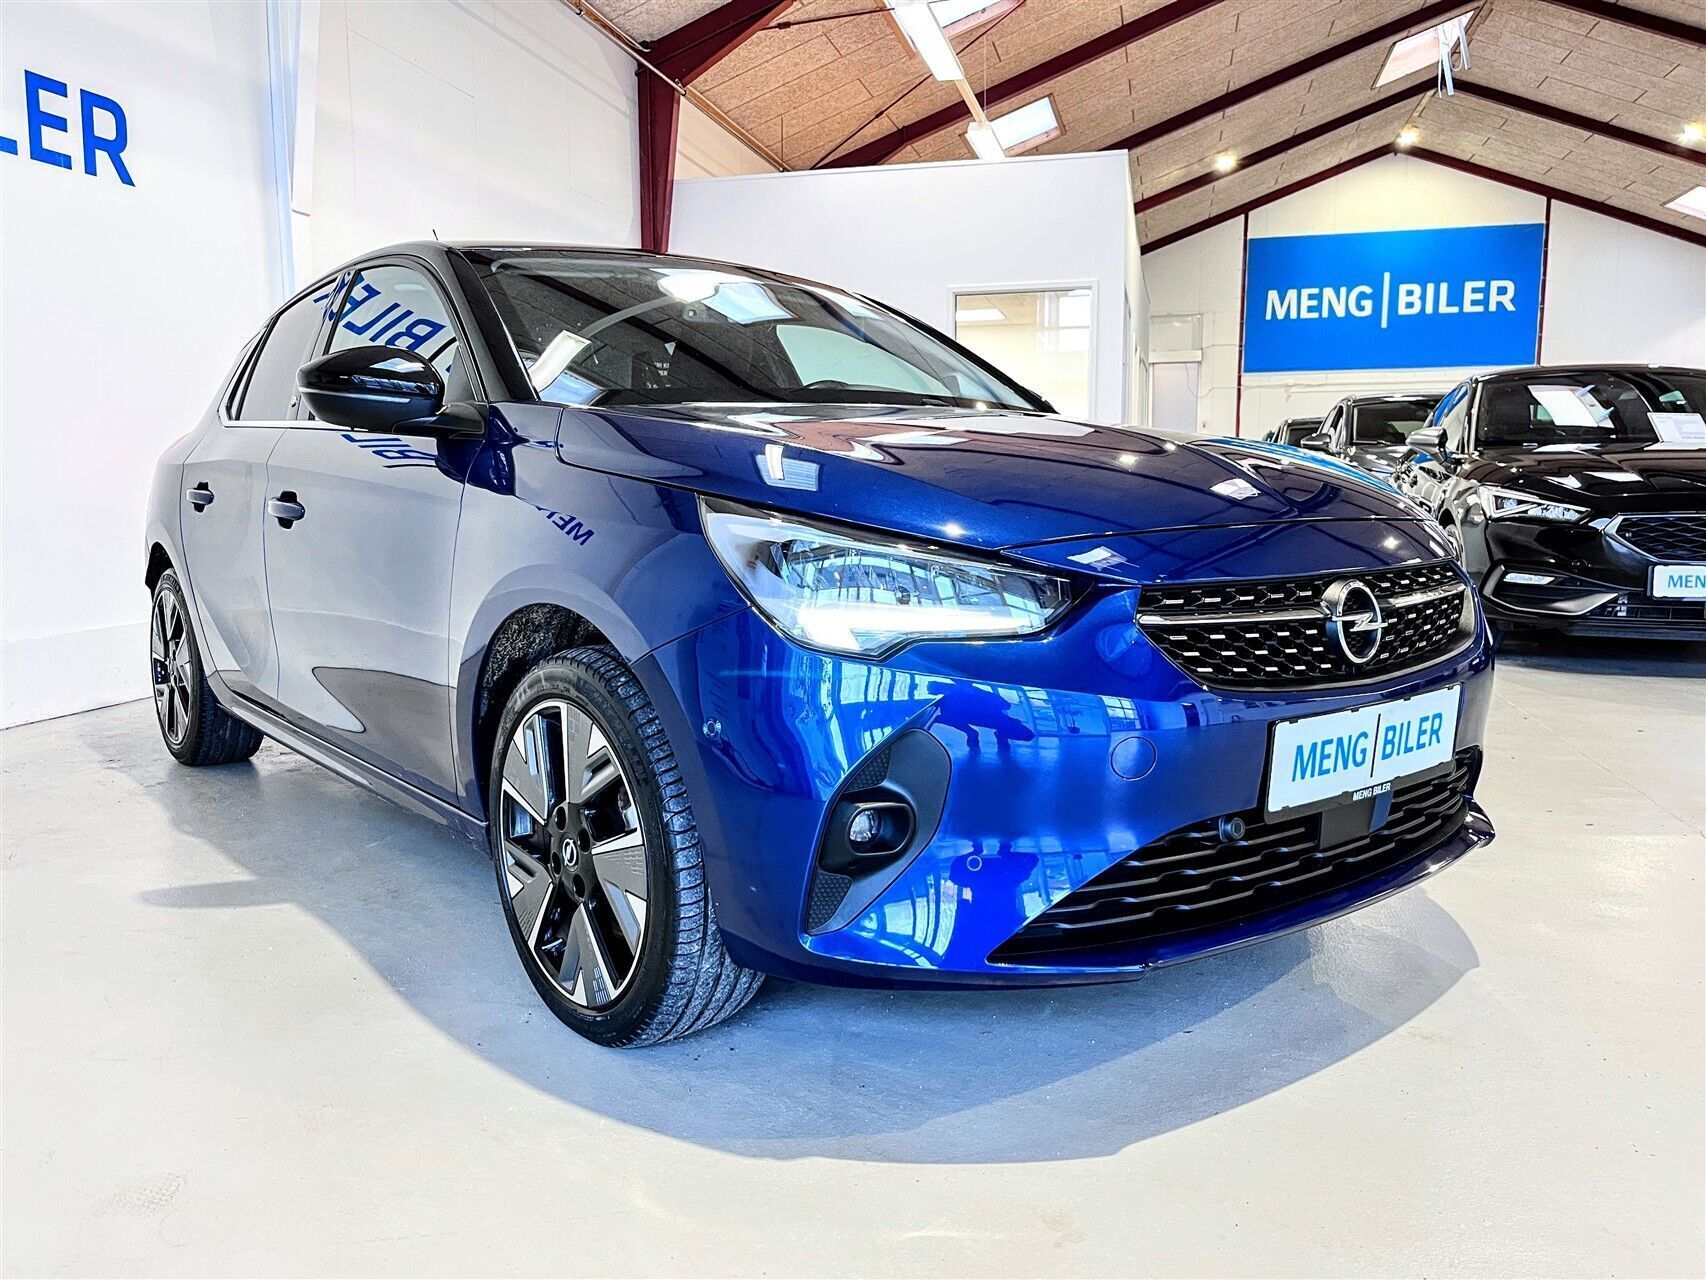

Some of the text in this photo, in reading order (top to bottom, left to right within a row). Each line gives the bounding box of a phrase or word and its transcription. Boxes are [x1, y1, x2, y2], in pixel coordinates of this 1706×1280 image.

[1265, 280, 1516, 320] MENG BILER
[1291, 712, 1443, 782] MENG BILER
[1352, 782, 1391, 801] MENG BILER
